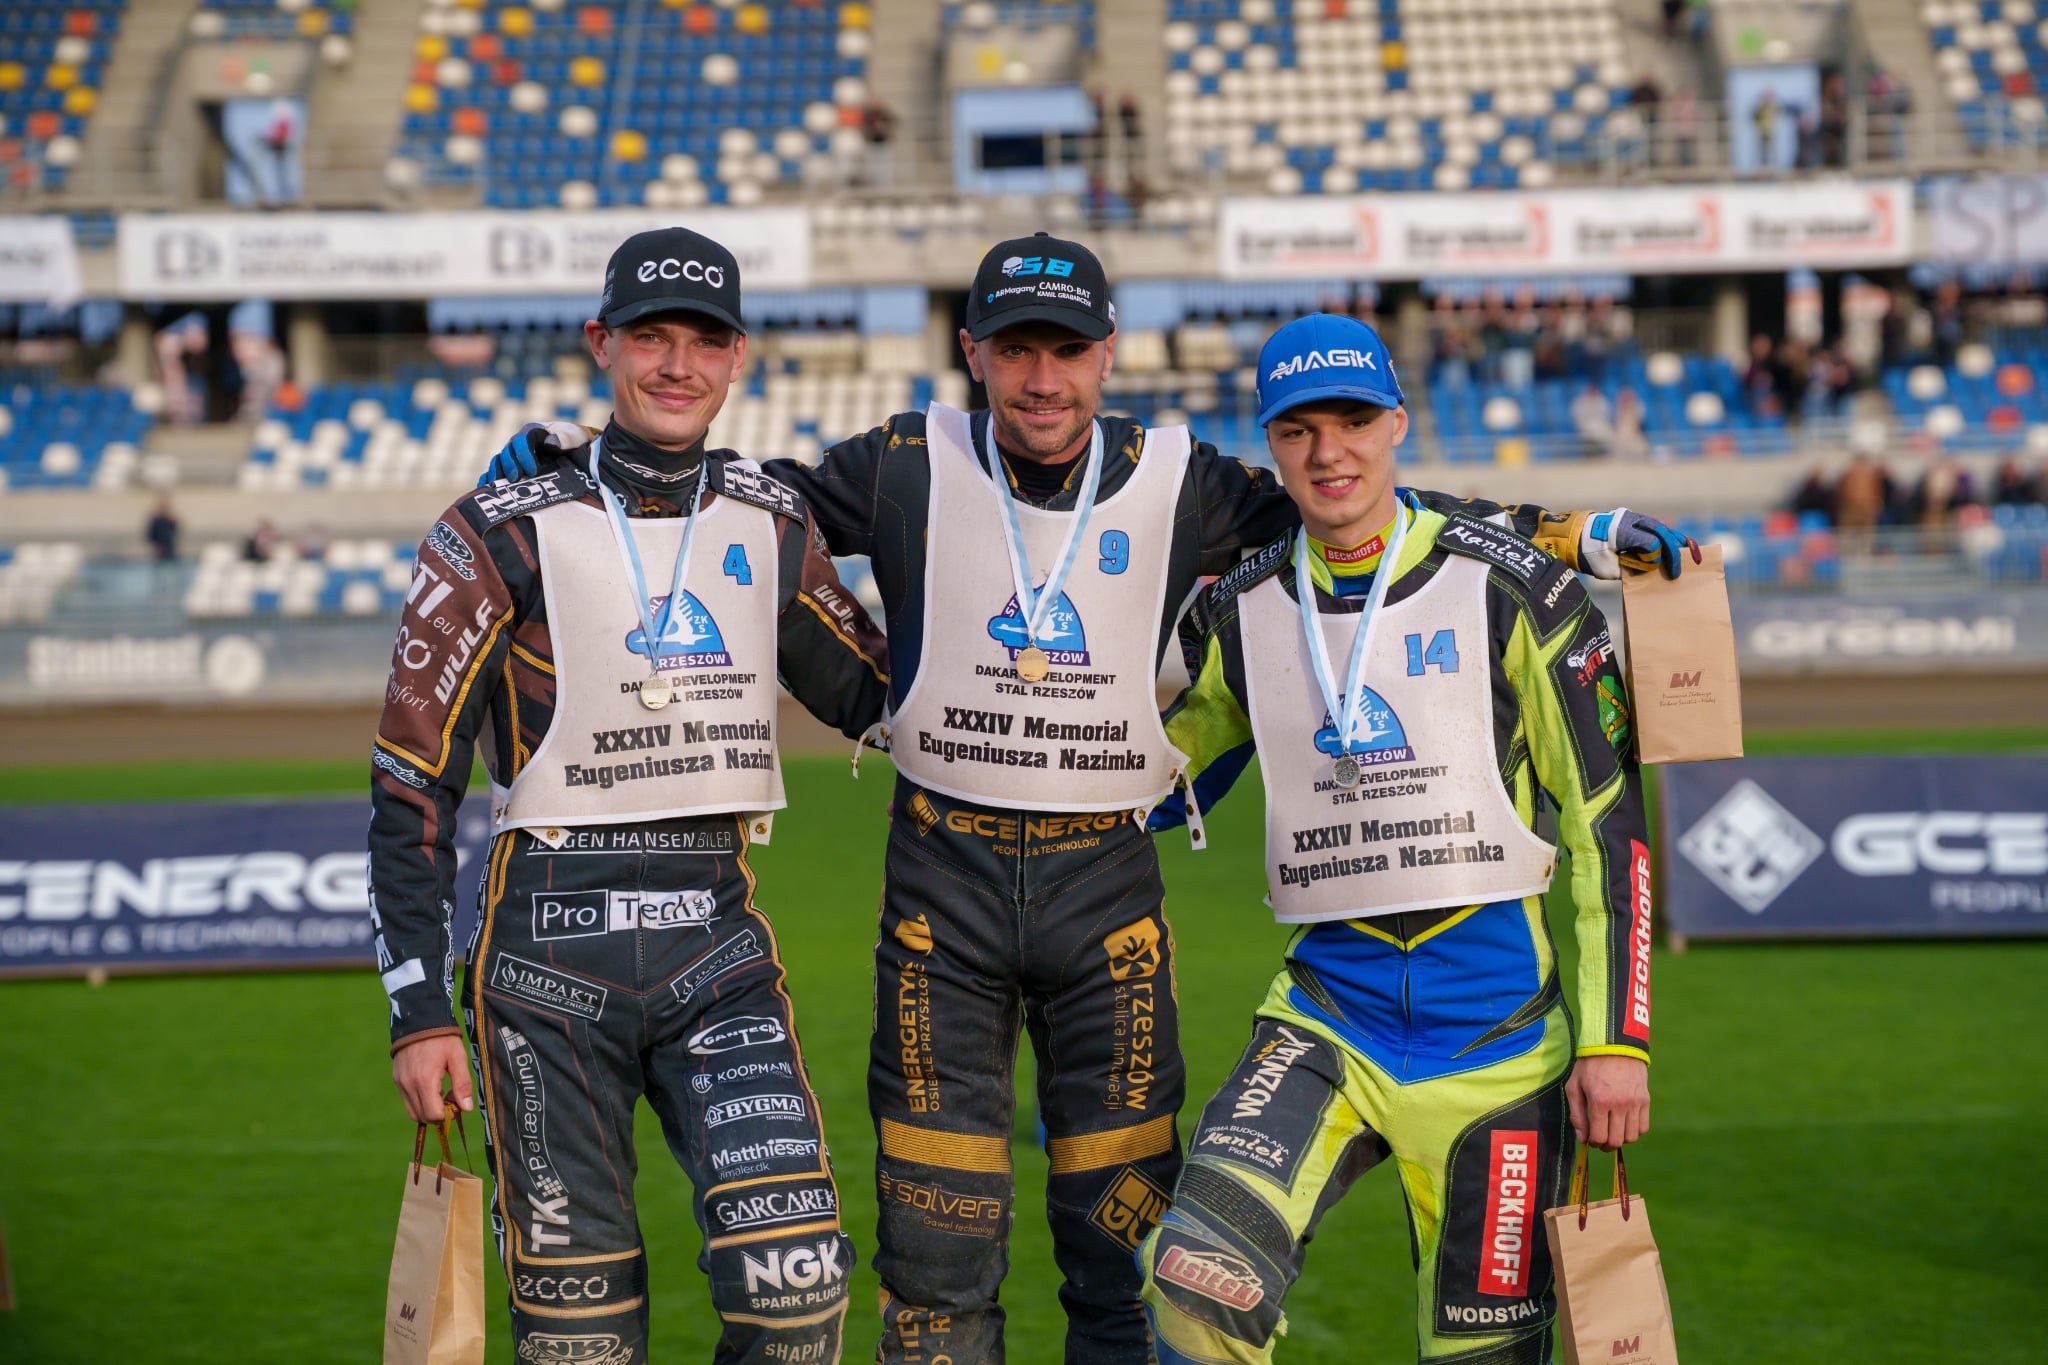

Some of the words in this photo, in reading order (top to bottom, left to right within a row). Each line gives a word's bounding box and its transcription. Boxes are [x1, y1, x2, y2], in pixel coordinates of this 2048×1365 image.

[637, 258, 724, 289] ecco
[1037, 290, 1056, 298] KAMIL
[1039, 281, 1091, 299] CAMRO-BAT
[1269, 349, 1377, 382] MAGIK
[1099, 530, 1129, 575] 9
[1327, 539, 1380, 561] BECKHOFF
[1453, 515, 1485, 533] FIRMA
[1485, 527, 1547, 565] BUDOWLANA
[723, 544, 752, 585] 4
[1483, 547, 1504, 562] Piotr
[1504, 557, 1531, 578] Mania
[434, 597, 493, 705] WULF
[1404, 629, 1460, 677] 14
[672, 673, 757, 688] DEVELOPMENT
[975, 664, 1018, 679] DAKAR
[1037, 671, 1116, 685] VELOPMENT
[685, 687, 743, 702] RZESZÓW
[995, 683, 1028, 696] STAL
[1032, 686, 1097, 700] RZESZÓW
[944, 706, 1014, 736] XXXIV
[592, 724, 672, 755] XXXIV
[918, 731, 1048, 769] Eugeniusza
[1059, 748, 1146, 771] Nazimka
[564, 754, 715, 789] Eugeniusza
[1360, 765, 1449, 785] EVELOPMENT
[1332, 792, 1359, 805] STAL
[1362, 783, 1428, 801] RZESZÓW
[612, 831, 695, 849] HANSEN
[697, 831, 732, 849] BILER
[1041, 837, 1100, 855] TECHNOLOGY
[1293, 823, 1352, 853] XXXIV
[1279, 855, 1390, 888] Eugeniusza
[1399, 840, 1505, 869] Nazimka
[543, 902, 597, 929] Pro
[1633, 855, 1651, 1028] BECKHOFF
[516, 984, 564, 1004] PRODUCENT
[564, 998, 595, 1014] ZNICZY
[519, 970, 598, 1006] IMPAKT
[1114, 985, 1130, 1036] stolica
[1126, 982, 1155, 1111] rzeszów
[922, 1056, 940, 1112] OSIEDLE
[516, 1052, 548, 1171] Belægning
[725, 1098, 802, 1118] BYGMA
[711, 1140, 818, 1169] Matthiesen
[1204, 1125, 1228, 1134] FIRMA
[1229, 1125, 1289, 1156] BUDOWLANA
[1228, 1146, 1249, 1157] Piotr
[1249, 1153, 1276, 1169] Mania
[716, 1188, 837, 1226] GARCAREK
[1491, 1143, 1529, 1286] BECKHOFF
[955, 1223, 996, 1236] technology
[741, 1235, 846, 1294] NGK
[751, 1294, 803, 1309] SPARK
[806, 1284, 842, 1306] PLUGS
[1445, 1299, 1539, 1324] WODSTAL
